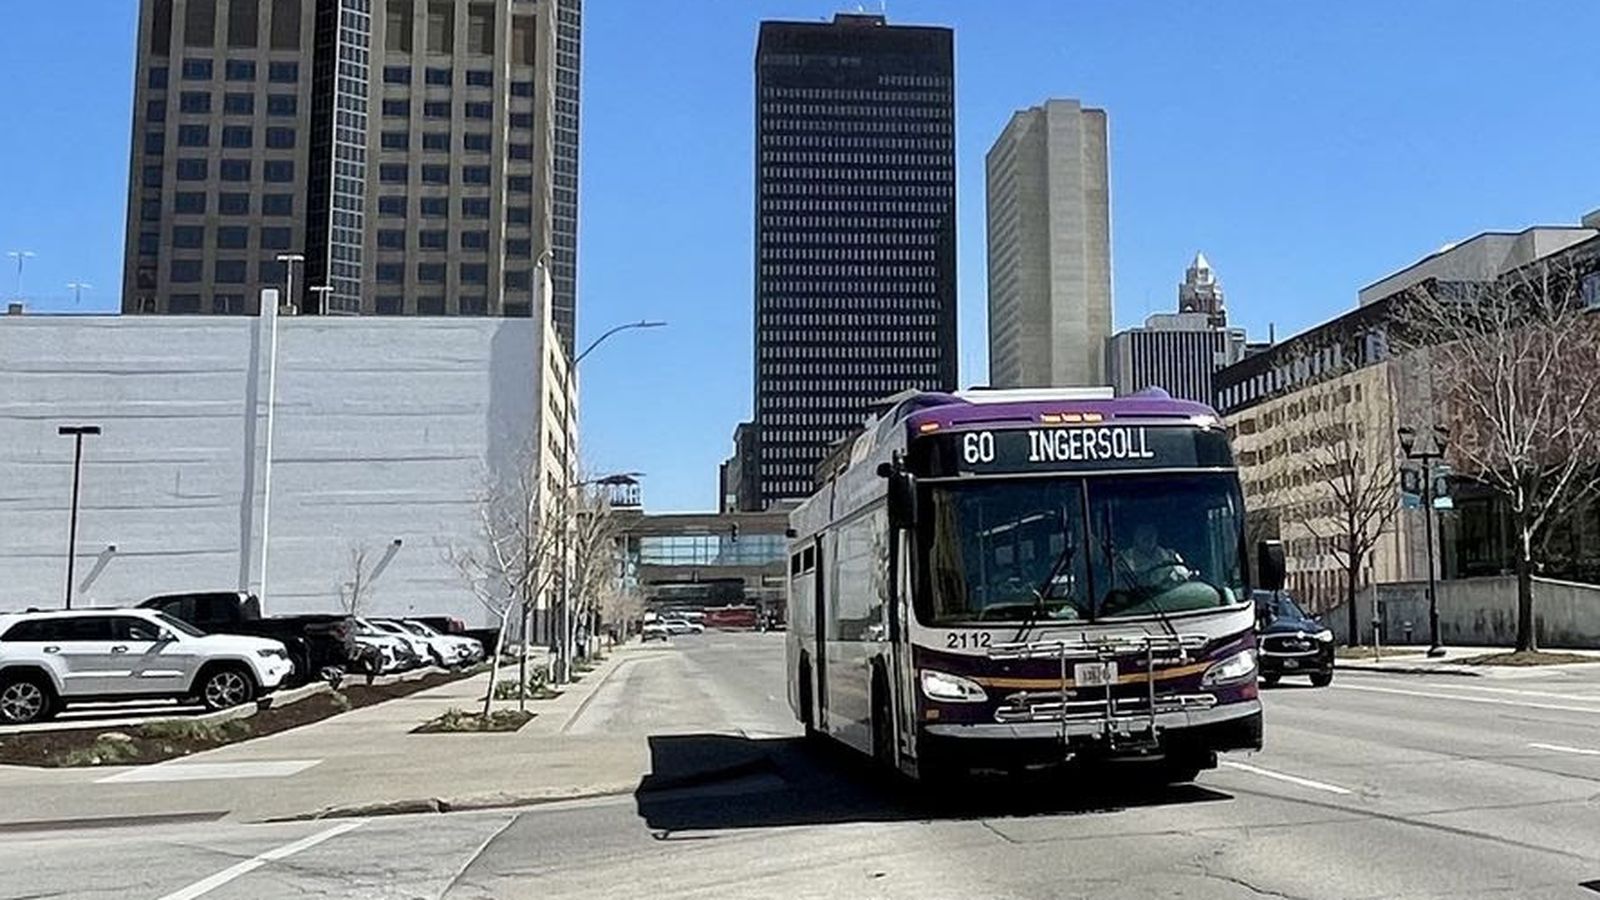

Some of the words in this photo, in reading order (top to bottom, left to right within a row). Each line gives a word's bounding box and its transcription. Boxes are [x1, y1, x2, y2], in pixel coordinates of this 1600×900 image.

[963, 431, 995, 464] 60
[1028, 427, 1154, 462] INGERSOLL
[947, 631, 992, 648] 2112
